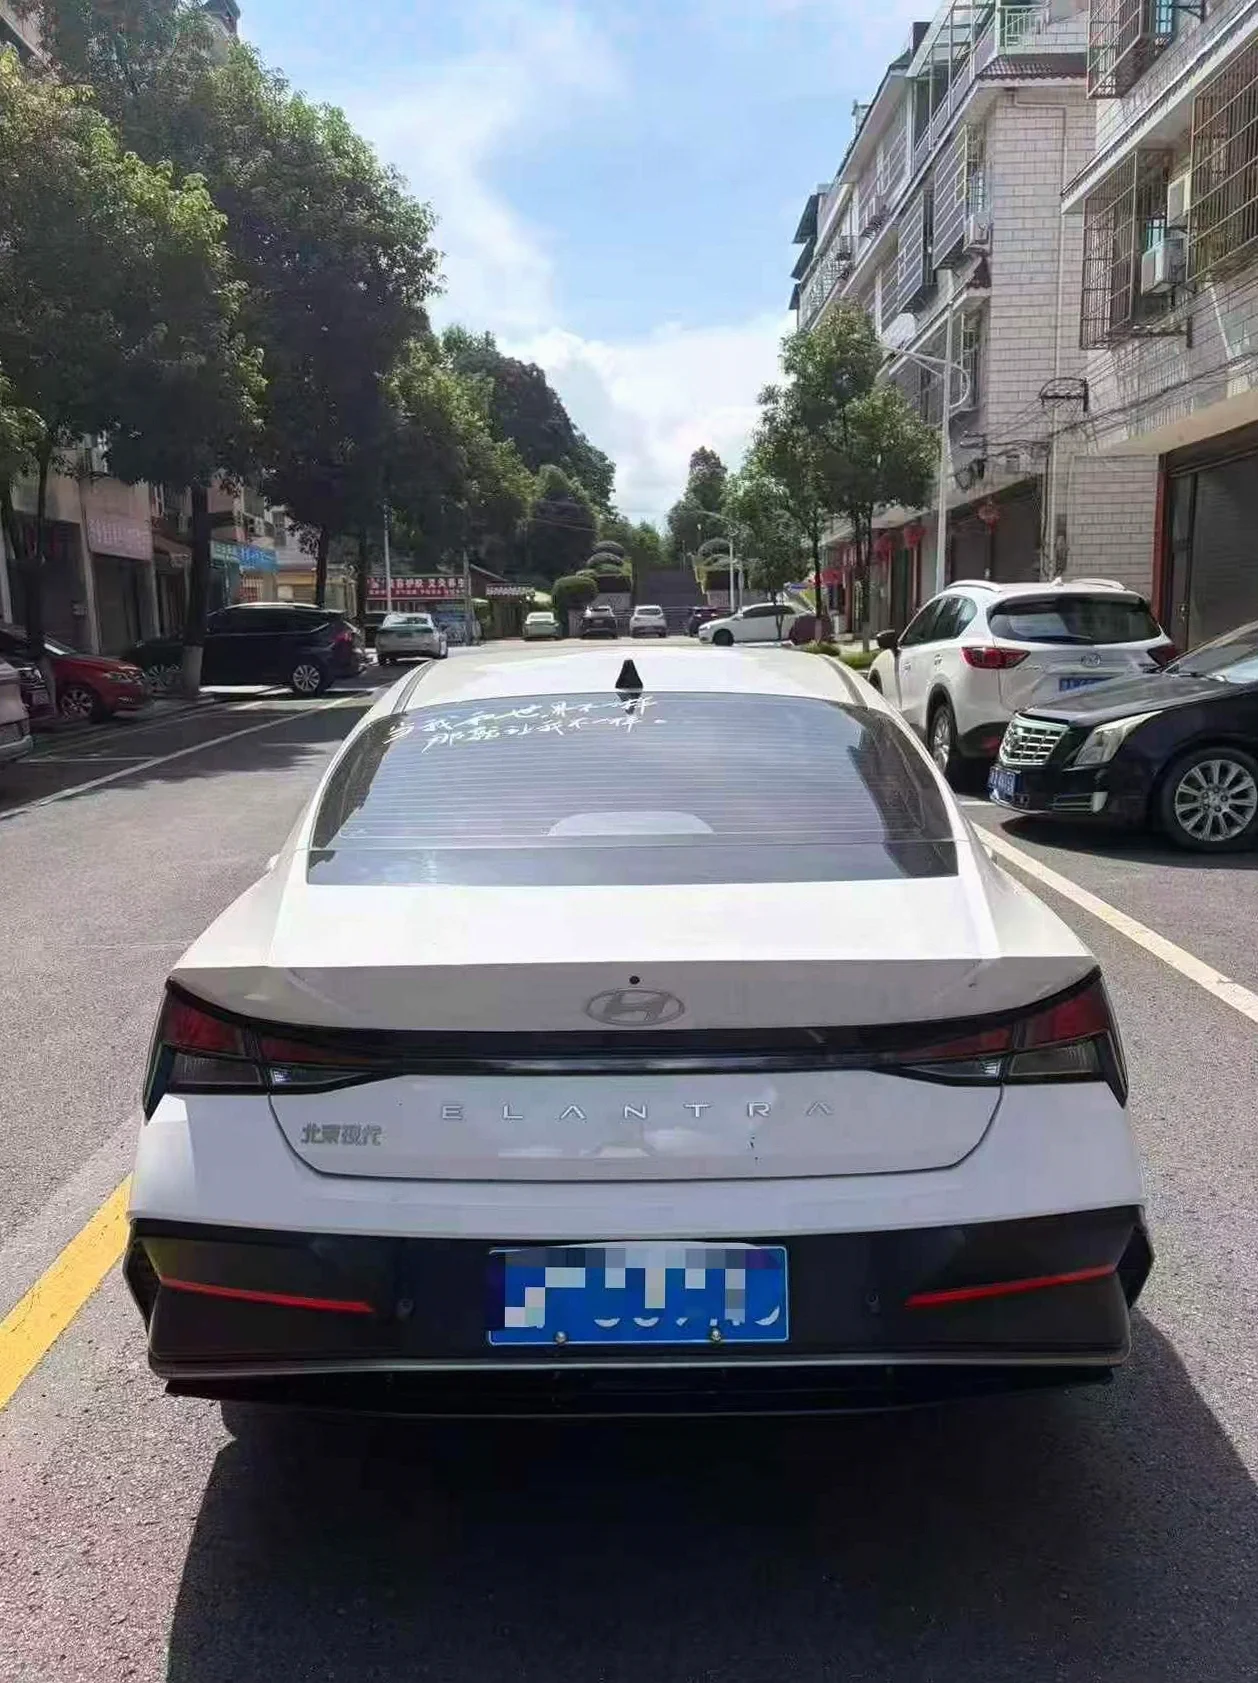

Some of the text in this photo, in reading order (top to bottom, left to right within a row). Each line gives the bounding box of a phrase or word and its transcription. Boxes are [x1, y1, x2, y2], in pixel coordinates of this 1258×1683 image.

[441, 1102, 834, 1120] ELANTRA
[300, 1121, 383, 1146] 北京现代
